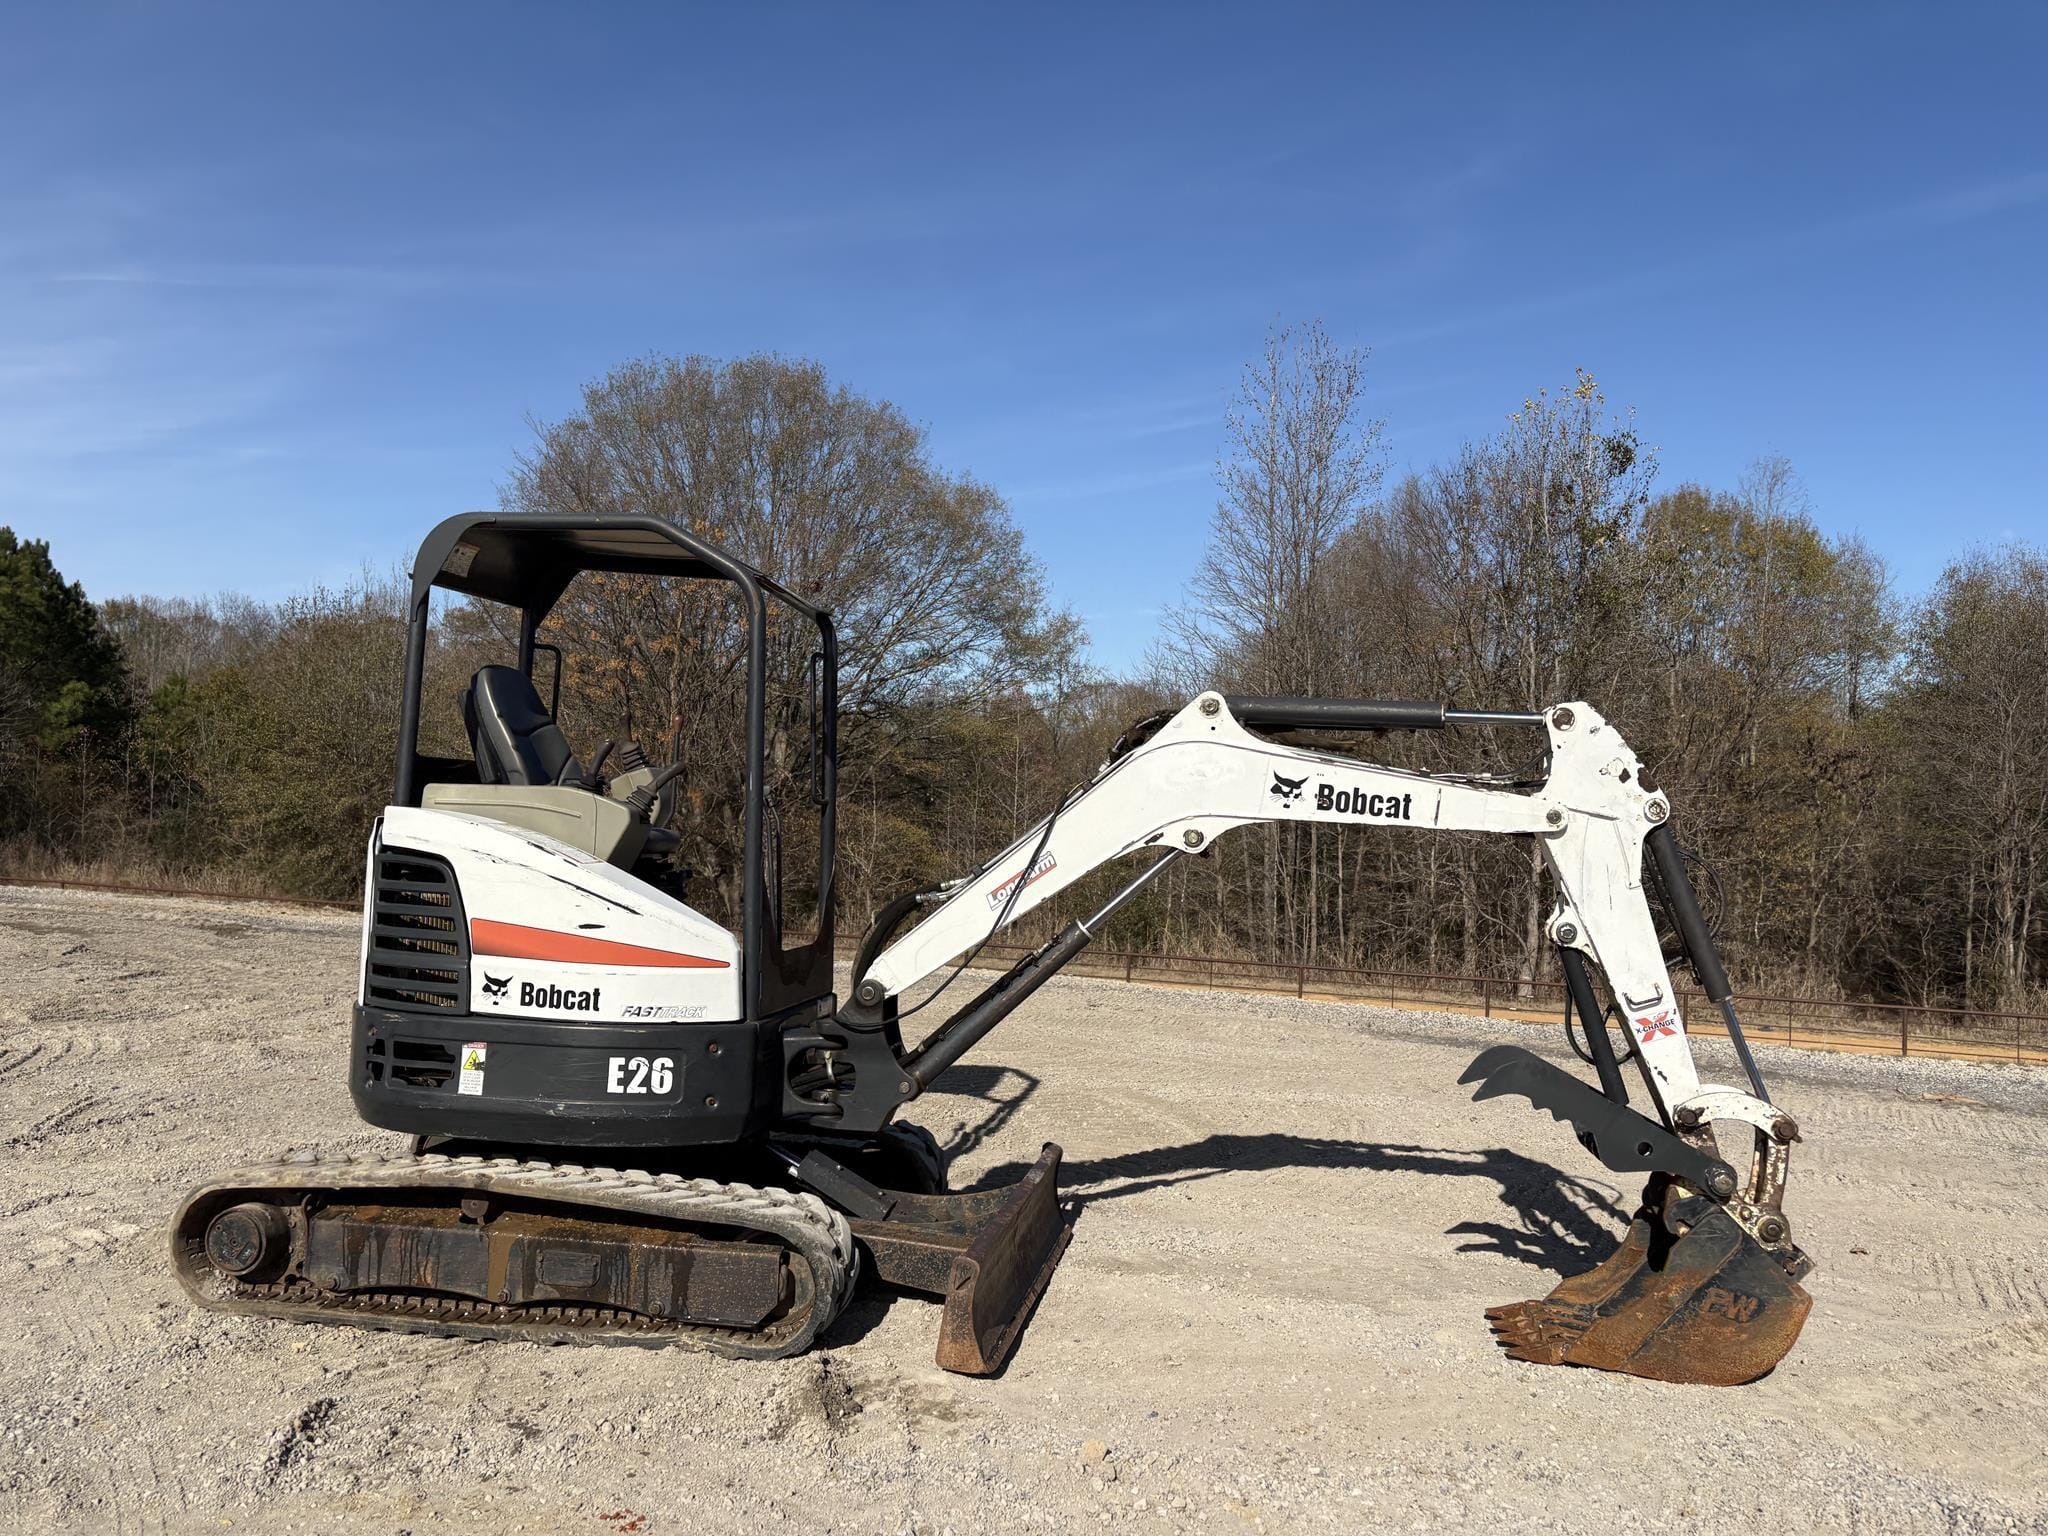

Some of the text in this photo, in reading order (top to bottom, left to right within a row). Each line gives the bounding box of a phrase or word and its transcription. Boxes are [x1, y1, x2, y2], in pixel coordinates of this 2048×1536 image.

[1317, 784, 1412, 820] Bobcat
[520, 982, 601, 1012] Bobcat
[622, 1005, 708, 1018] FASTTRACK
[1635, 1018, 1675, 1034] X-CHANGE
[607, 1056, 674, 1094] E26
